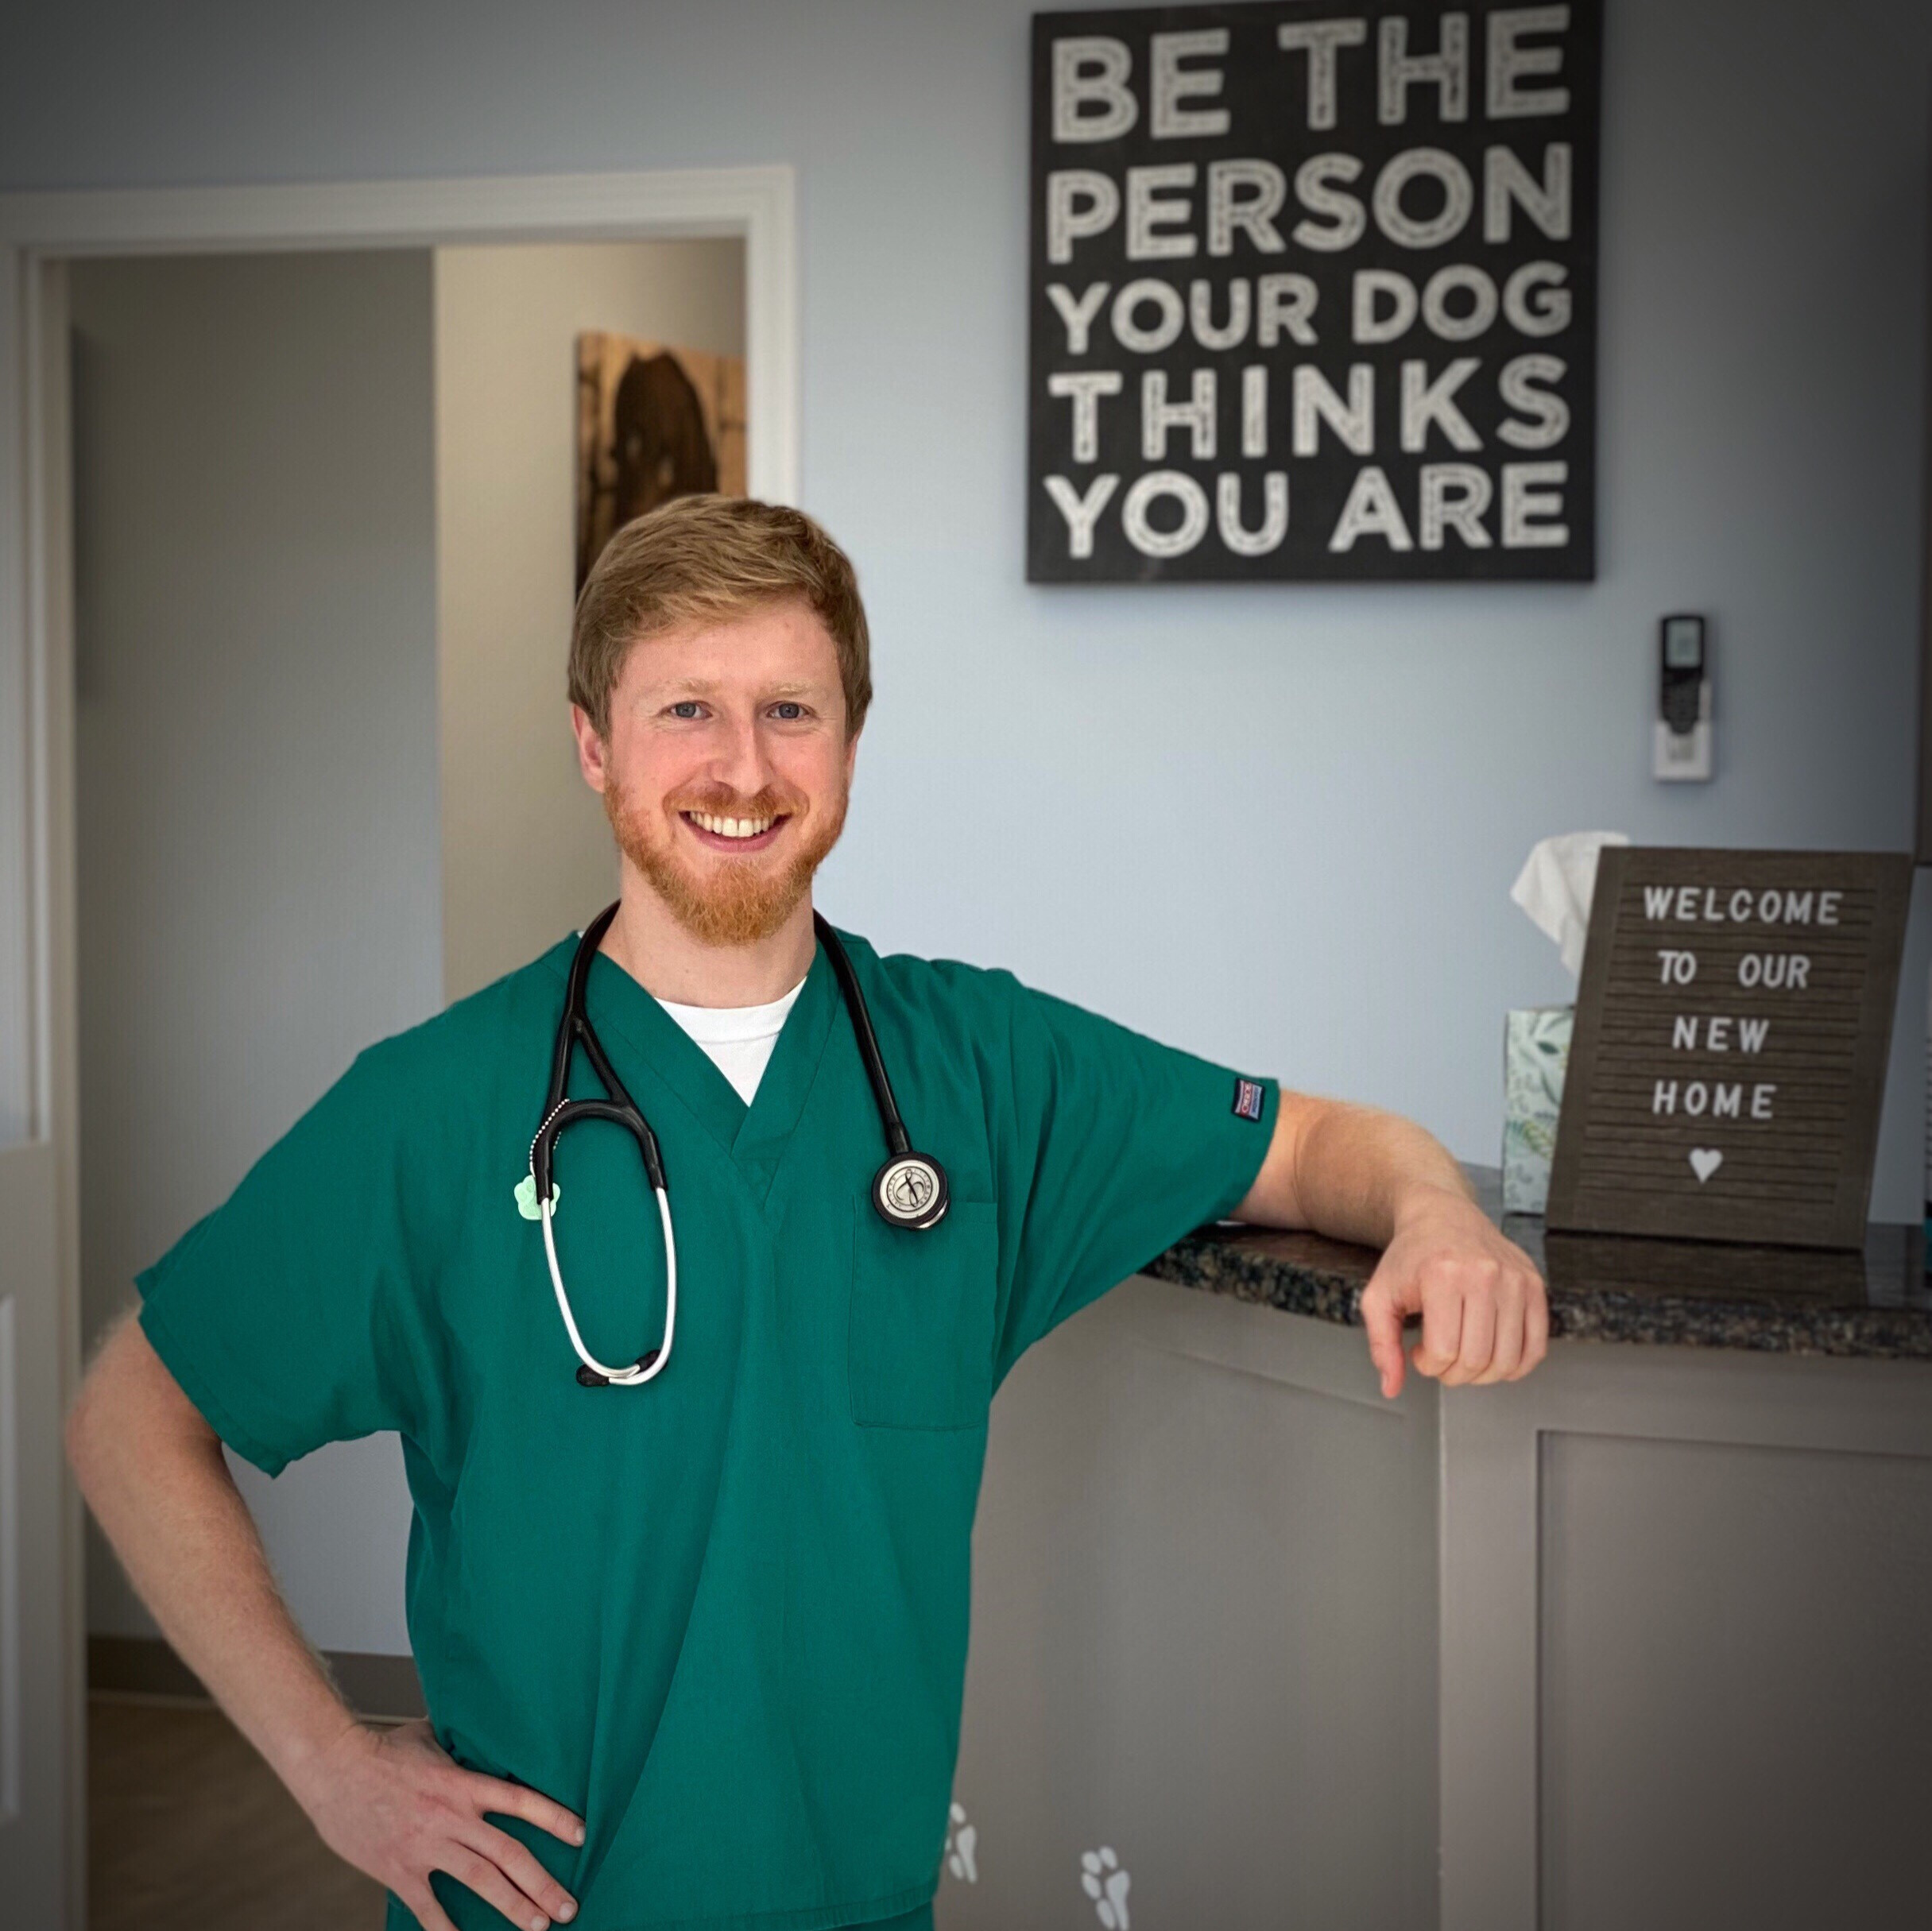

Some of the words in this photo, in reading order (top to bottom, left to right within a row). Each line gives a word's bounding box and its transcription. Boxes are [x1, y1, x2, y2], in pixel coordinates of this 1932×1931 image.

[1051, 29, 1230, 143] BE
[1278, 4, 1571, 130] THE
[1046, 142, 1572, 265] PERSON
[1045, 273, 1319, 355] YOUR
[1351, 261, 1572, 345] DOG
[1047, 353, 1571, 464] THINKS
[1042, 470, 1289, 559] YOU
[1328, 461, 1570, 553] ARE
[1644, 886, 1843, 925] WELCOME
[1657, 950, 1698, 985] TO
[1738, 954, 1811, 989] OUR
[1672, 1016, 1769, 1053] NEW
[1652, 1080, 1777, 1119] HOME
